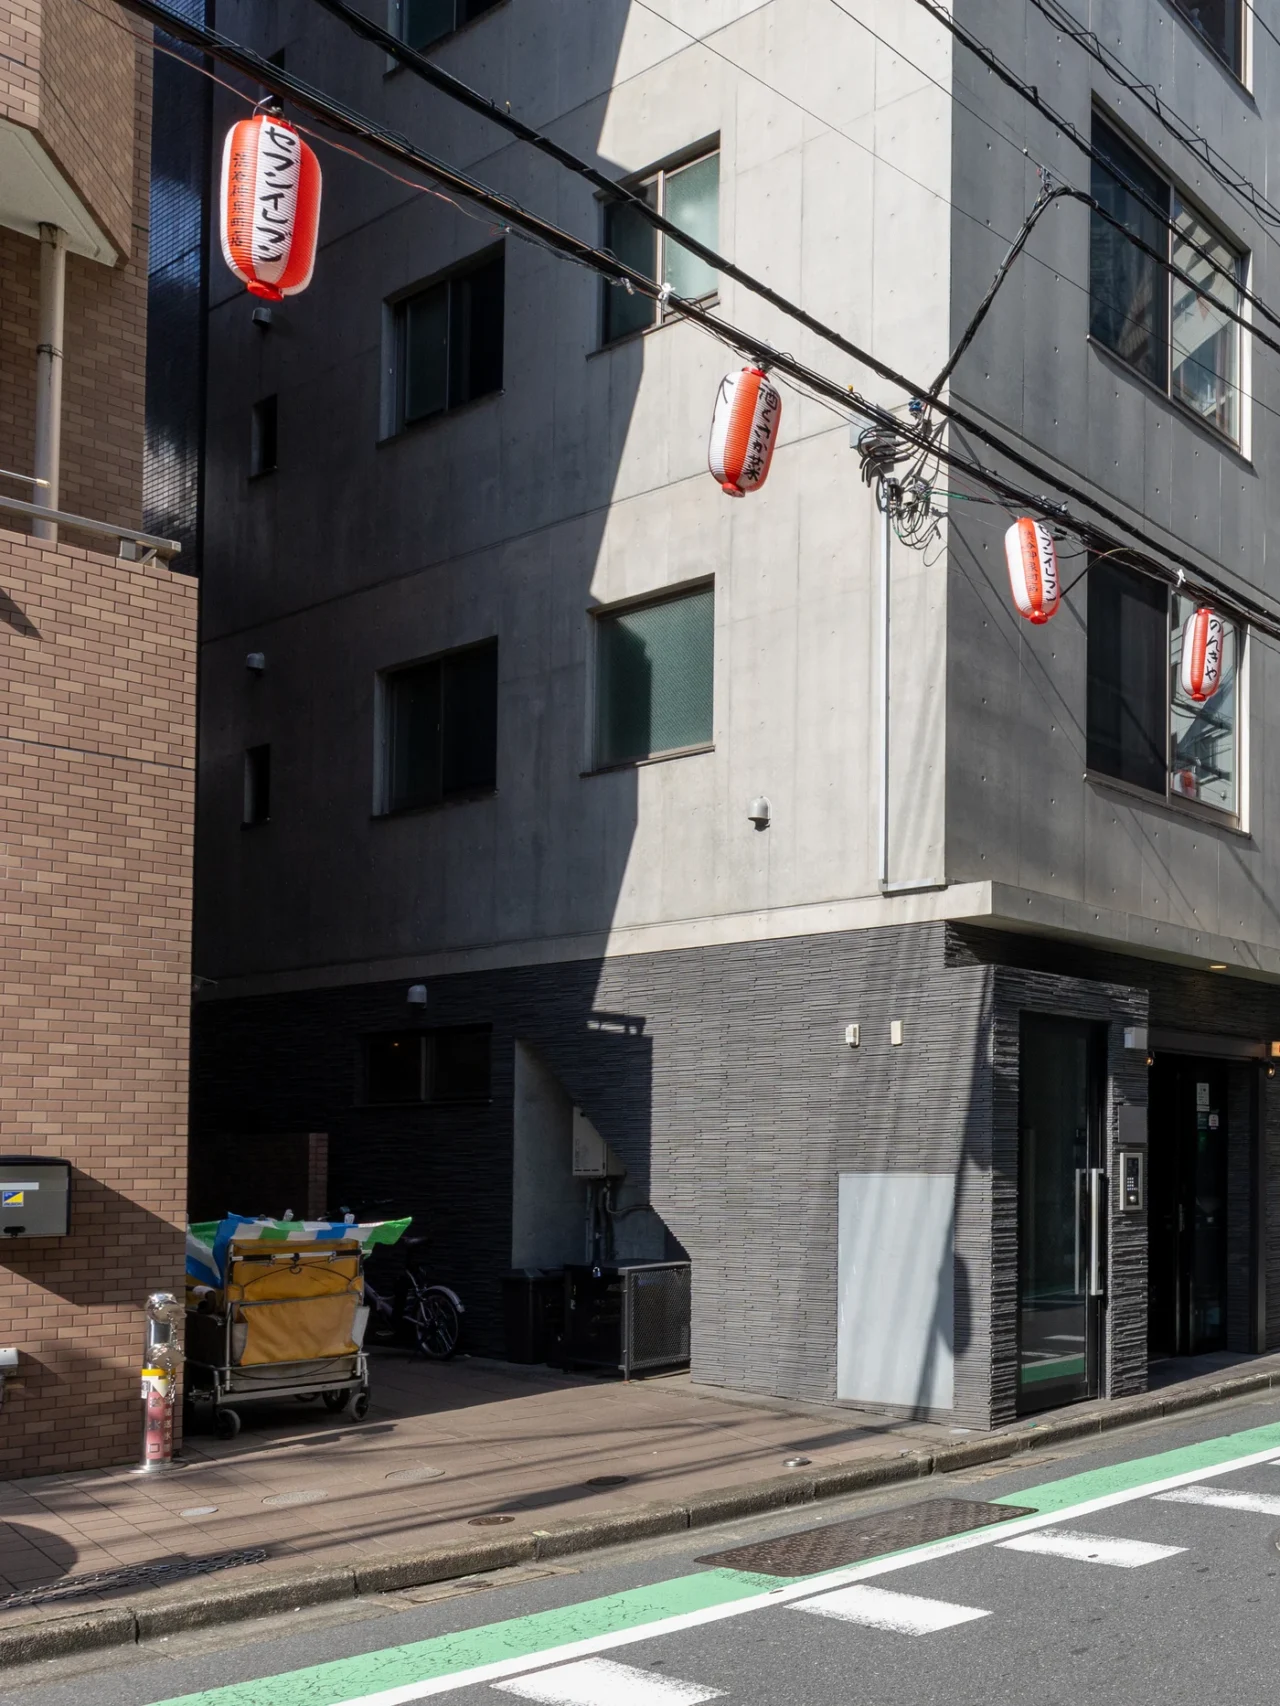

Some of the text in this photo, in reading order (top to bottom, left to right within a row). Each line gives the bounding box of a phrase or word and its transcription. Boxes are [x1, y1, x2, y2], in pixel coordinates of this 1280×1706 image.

[256, 125, 300, 262] セブンイレブン
